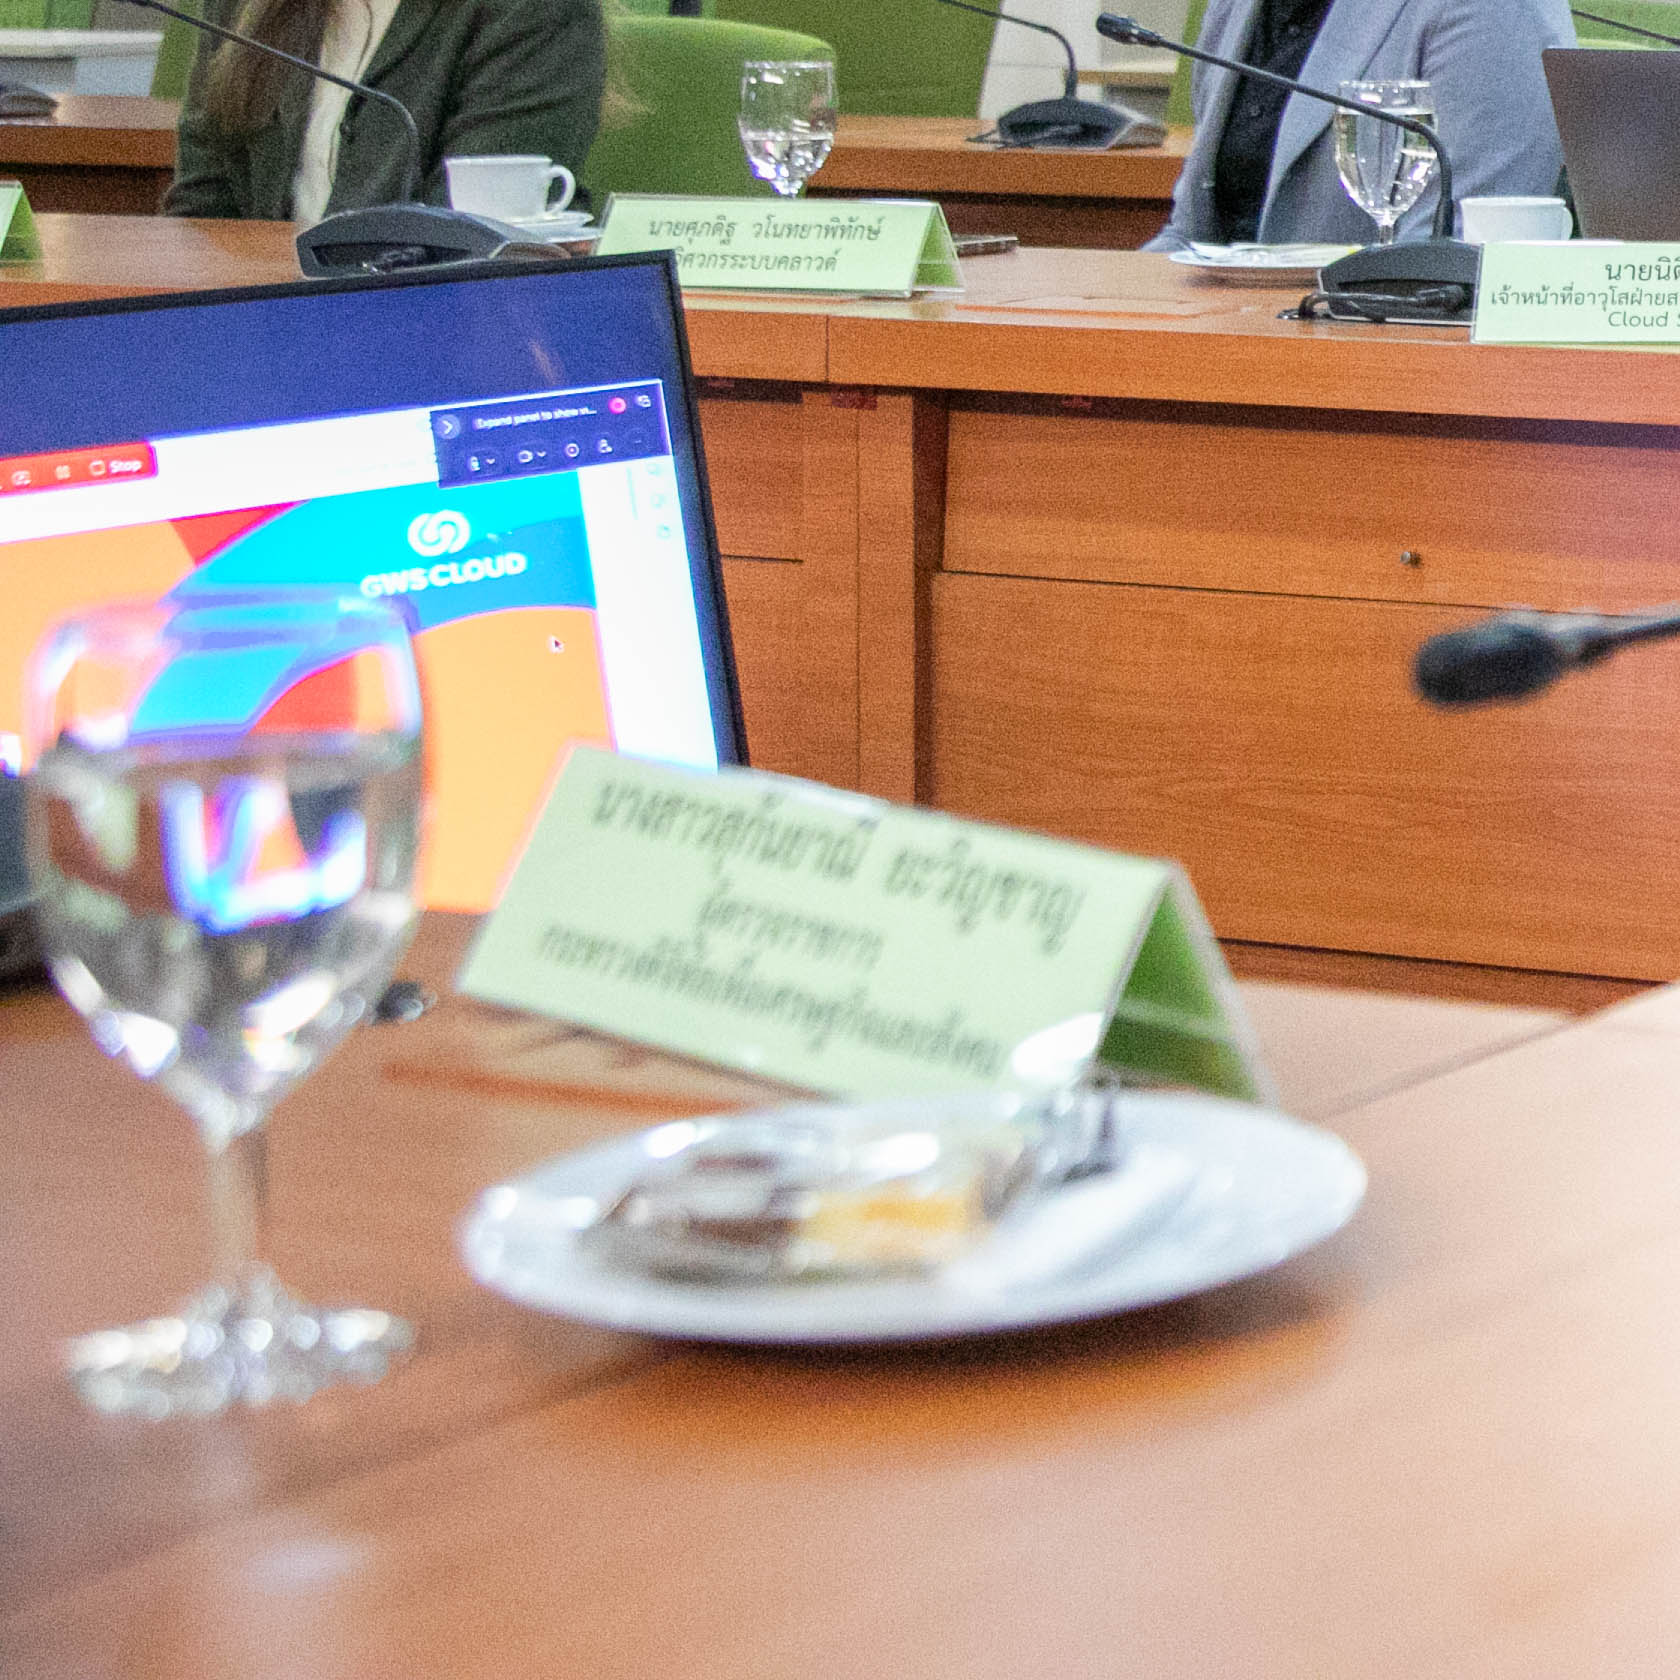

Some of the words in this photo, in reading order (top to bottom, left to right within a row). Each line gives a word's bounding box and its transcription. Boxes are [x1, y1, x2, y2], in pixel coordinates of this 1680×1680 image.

[1608, 311, 1669, 328] Cloud
[109, 460, 143, 475] Stop
[429, 552, 528, 587] CLOUD
